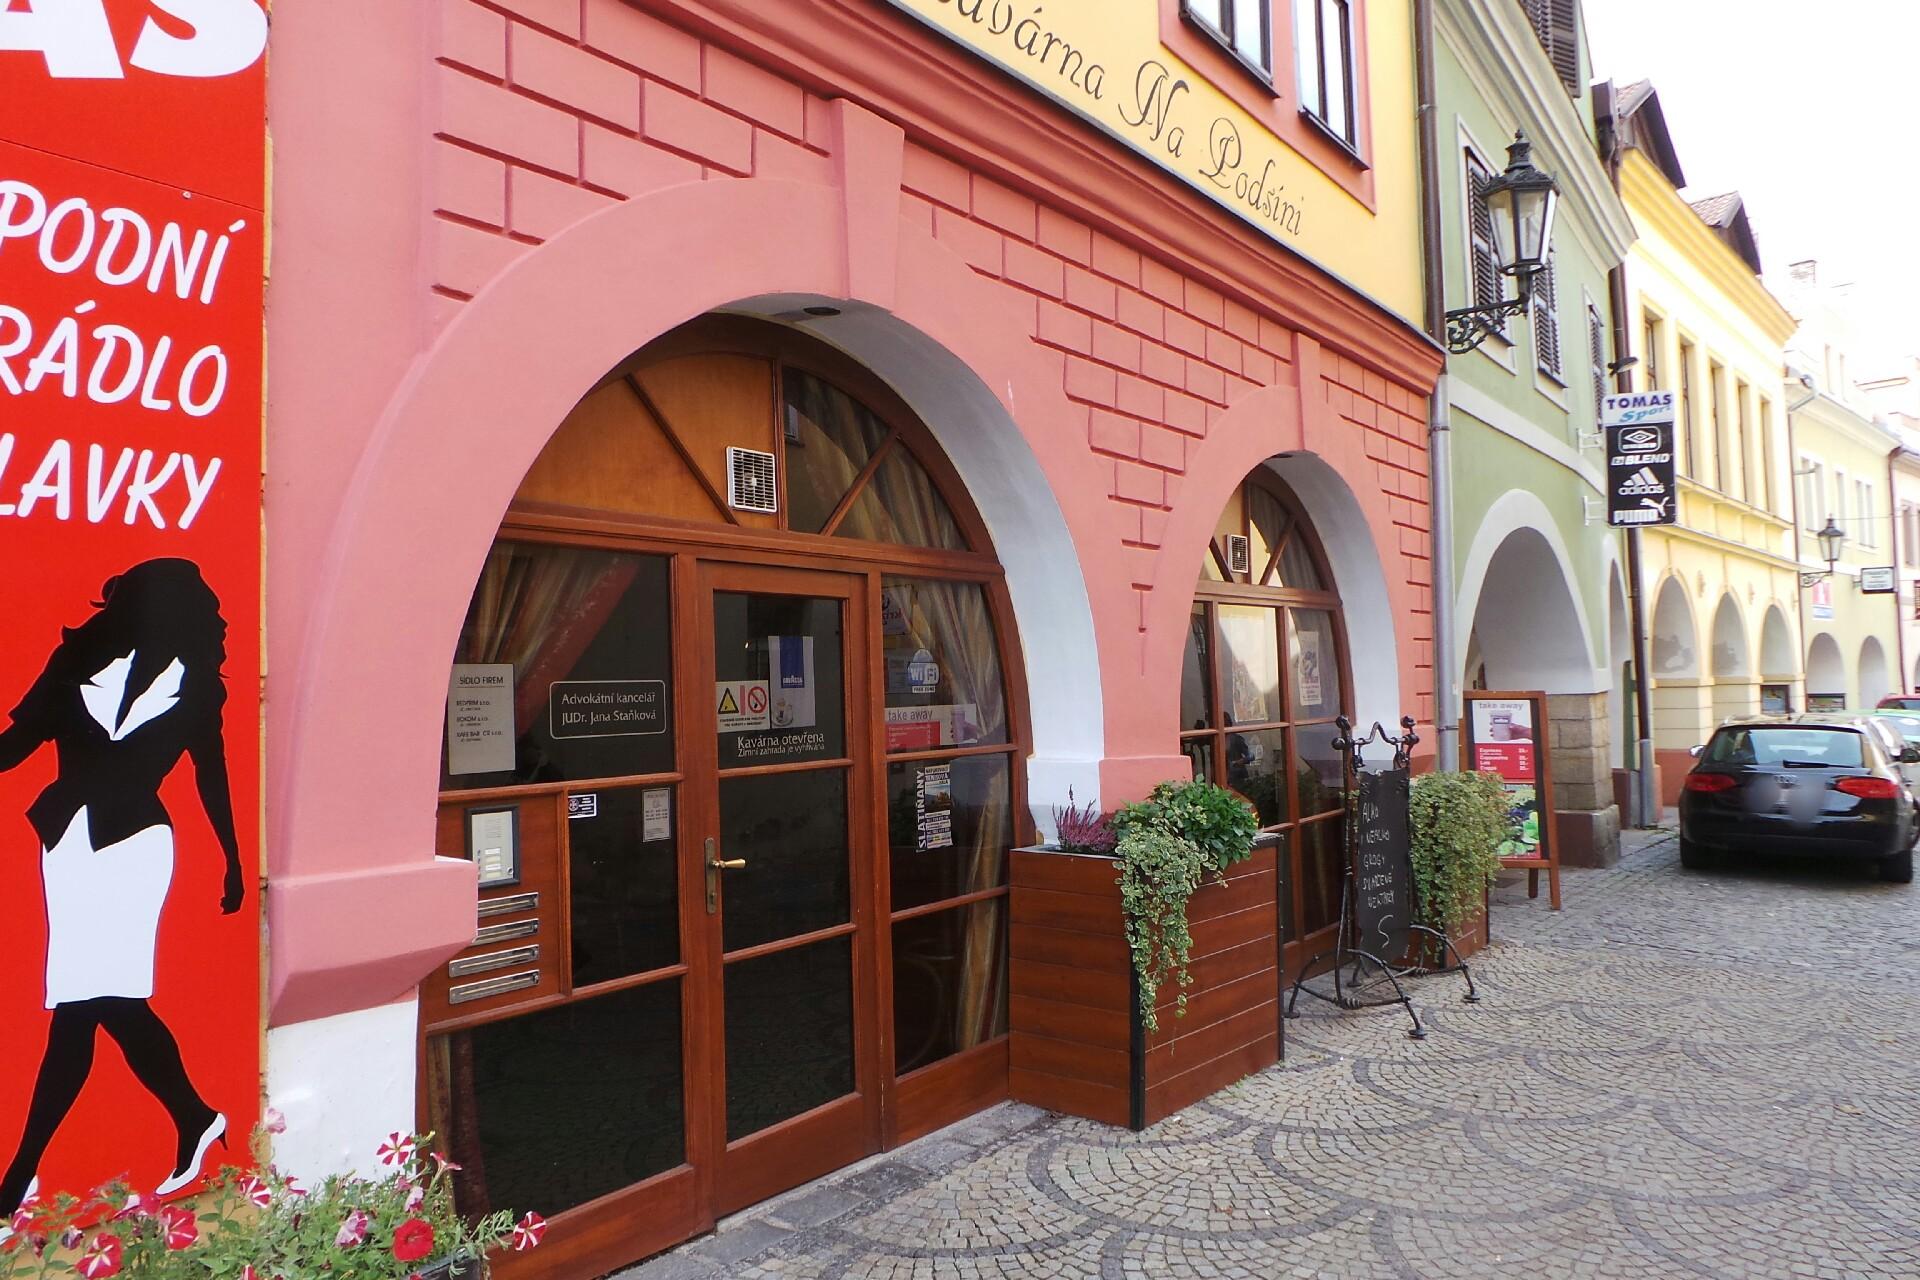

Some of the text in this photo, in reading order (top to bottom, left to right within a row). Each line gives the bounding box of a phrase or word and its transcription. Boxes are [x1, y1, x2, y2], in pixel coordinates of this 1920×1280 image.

[938, 0, 1103, 100] avárna
[1118, 60, 1189, 158] Na
[1607, 394, 1672, 410] TOMAS
[459, 674, 504, 685] SÍDLO FIREM
[561, 692, 614, 705] Advokátní
[562, 709, 657, 726] JUDr. Jana Staňková
[888, 709, 933, 721] take away
[737, 731, 825, 749] Kavárna otevřena
